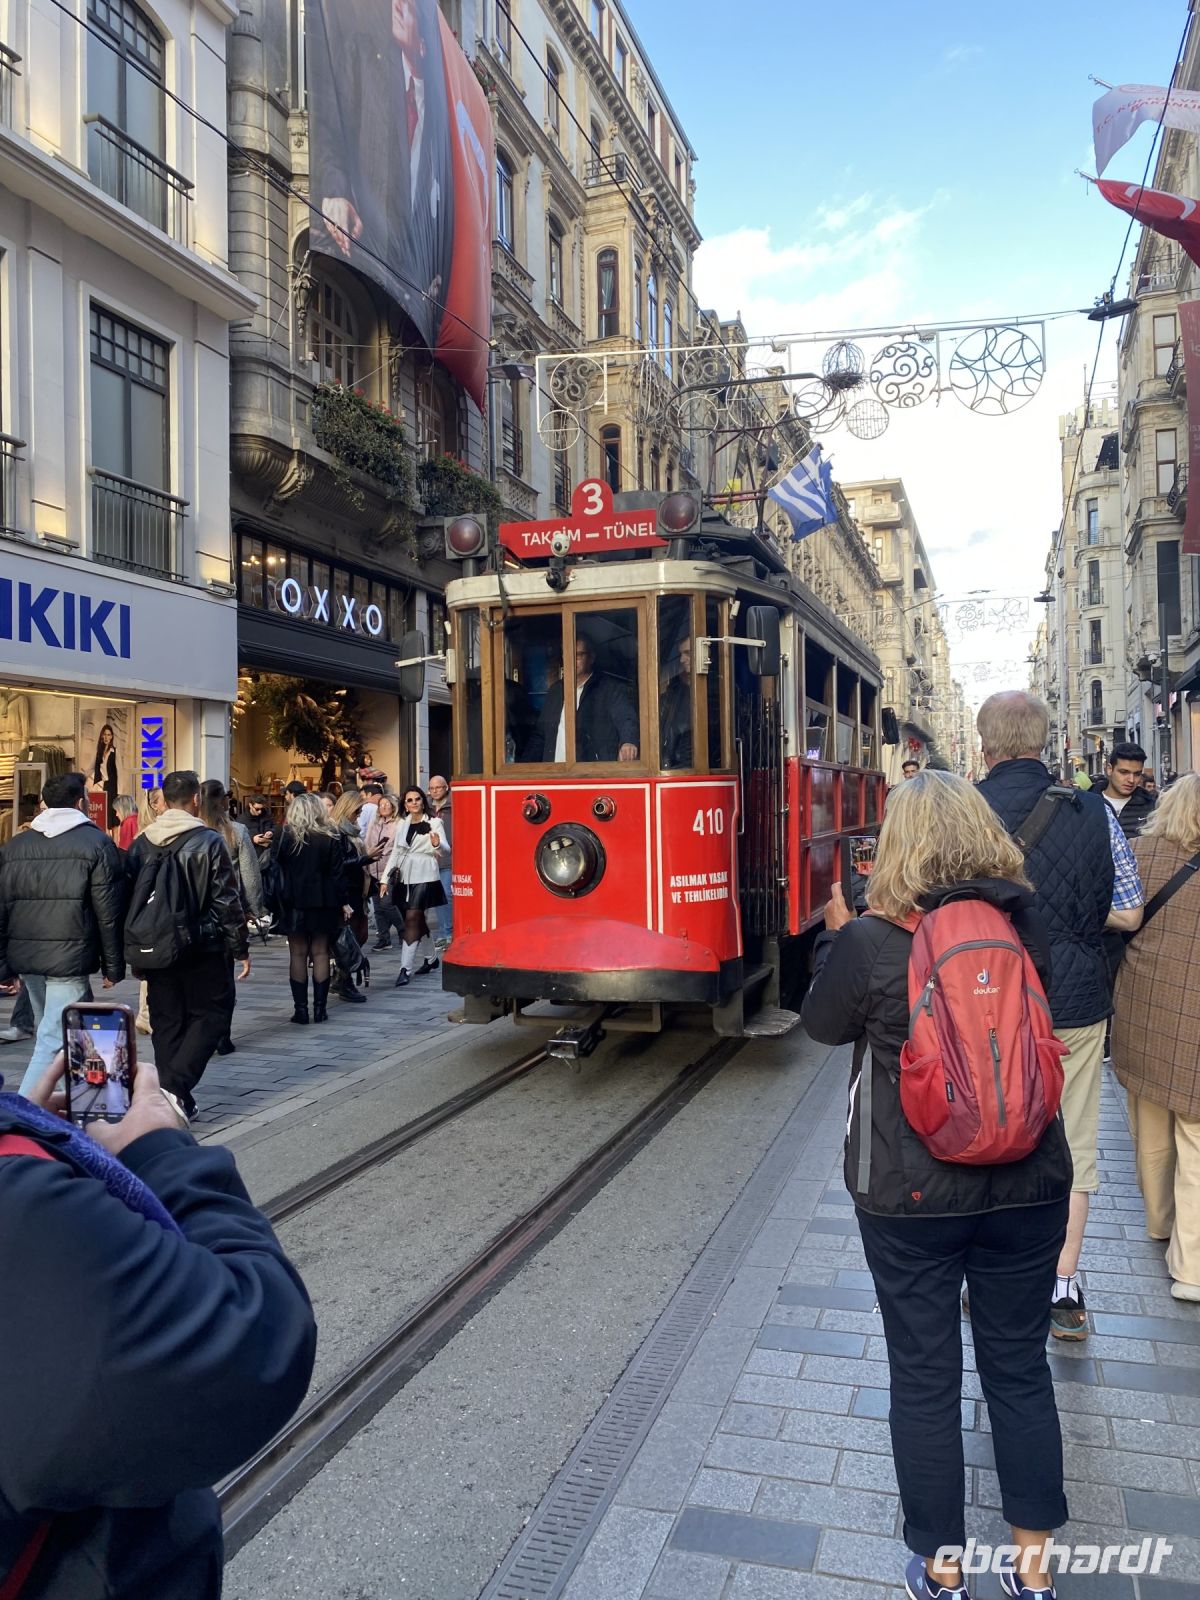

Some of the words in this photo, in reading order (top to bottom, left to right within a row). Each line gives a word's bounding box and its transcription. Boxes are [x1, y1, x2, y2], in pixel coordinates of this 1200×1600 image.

[582, 483, 604, 515] 3
[603, 521, 656, 540] TÜNEL
[281, 578, 382, 635] OXXO
[692, 807, 724, 836] 410
[670, 873, 707, 887] ASILMAK
[709, 871, 728, 884] YASAK
[671, 891, 682, 903] VE
